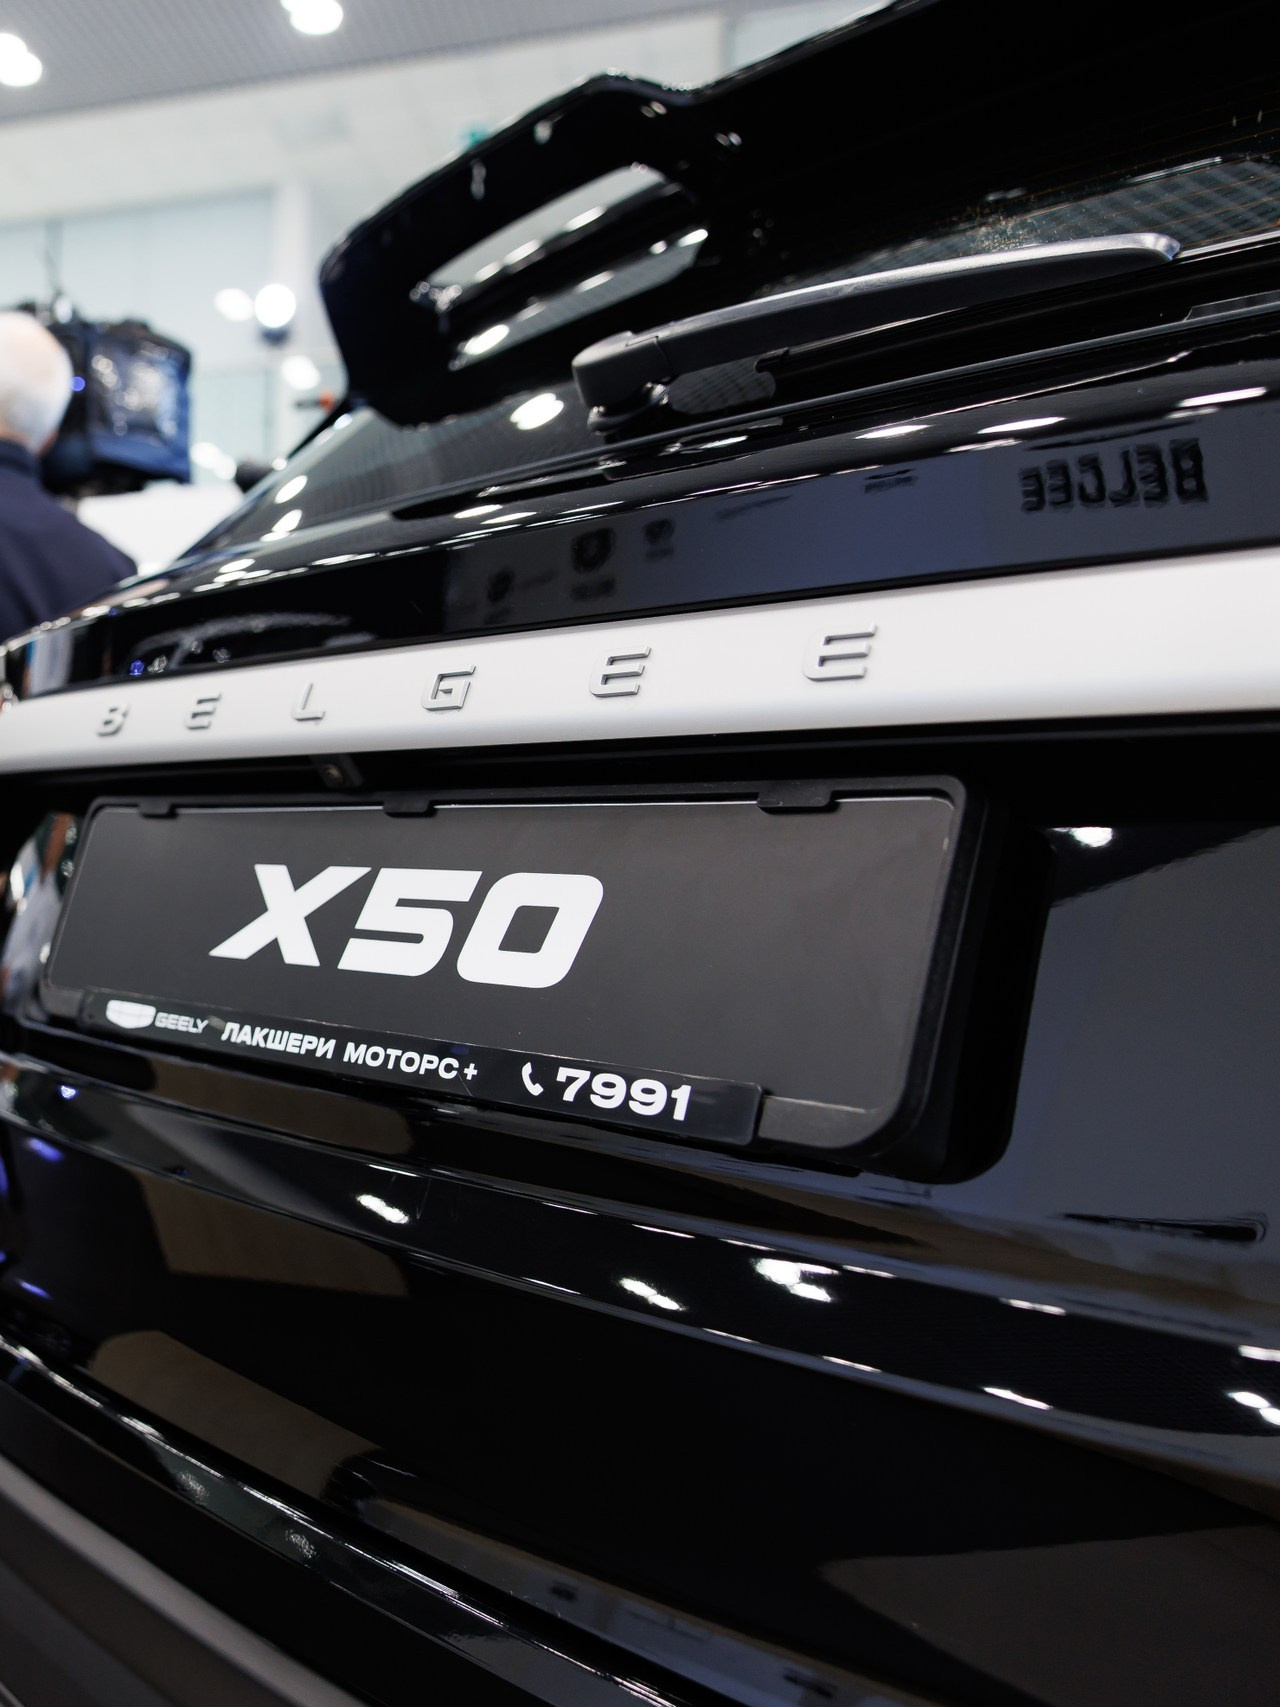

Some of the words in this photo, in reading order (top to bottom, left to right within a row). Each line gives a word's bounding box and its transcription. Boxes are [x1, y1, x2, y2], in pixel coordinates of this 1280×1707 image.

[96, 624, 878, 737] BELGEE
[209, 864, 604, 989] X50
[154, 1012, 209, 1034] GEELY
[221, 1022, 336, 1060] ЛАКШЕРИ
[556, 1066, 691, 1121] 7991
